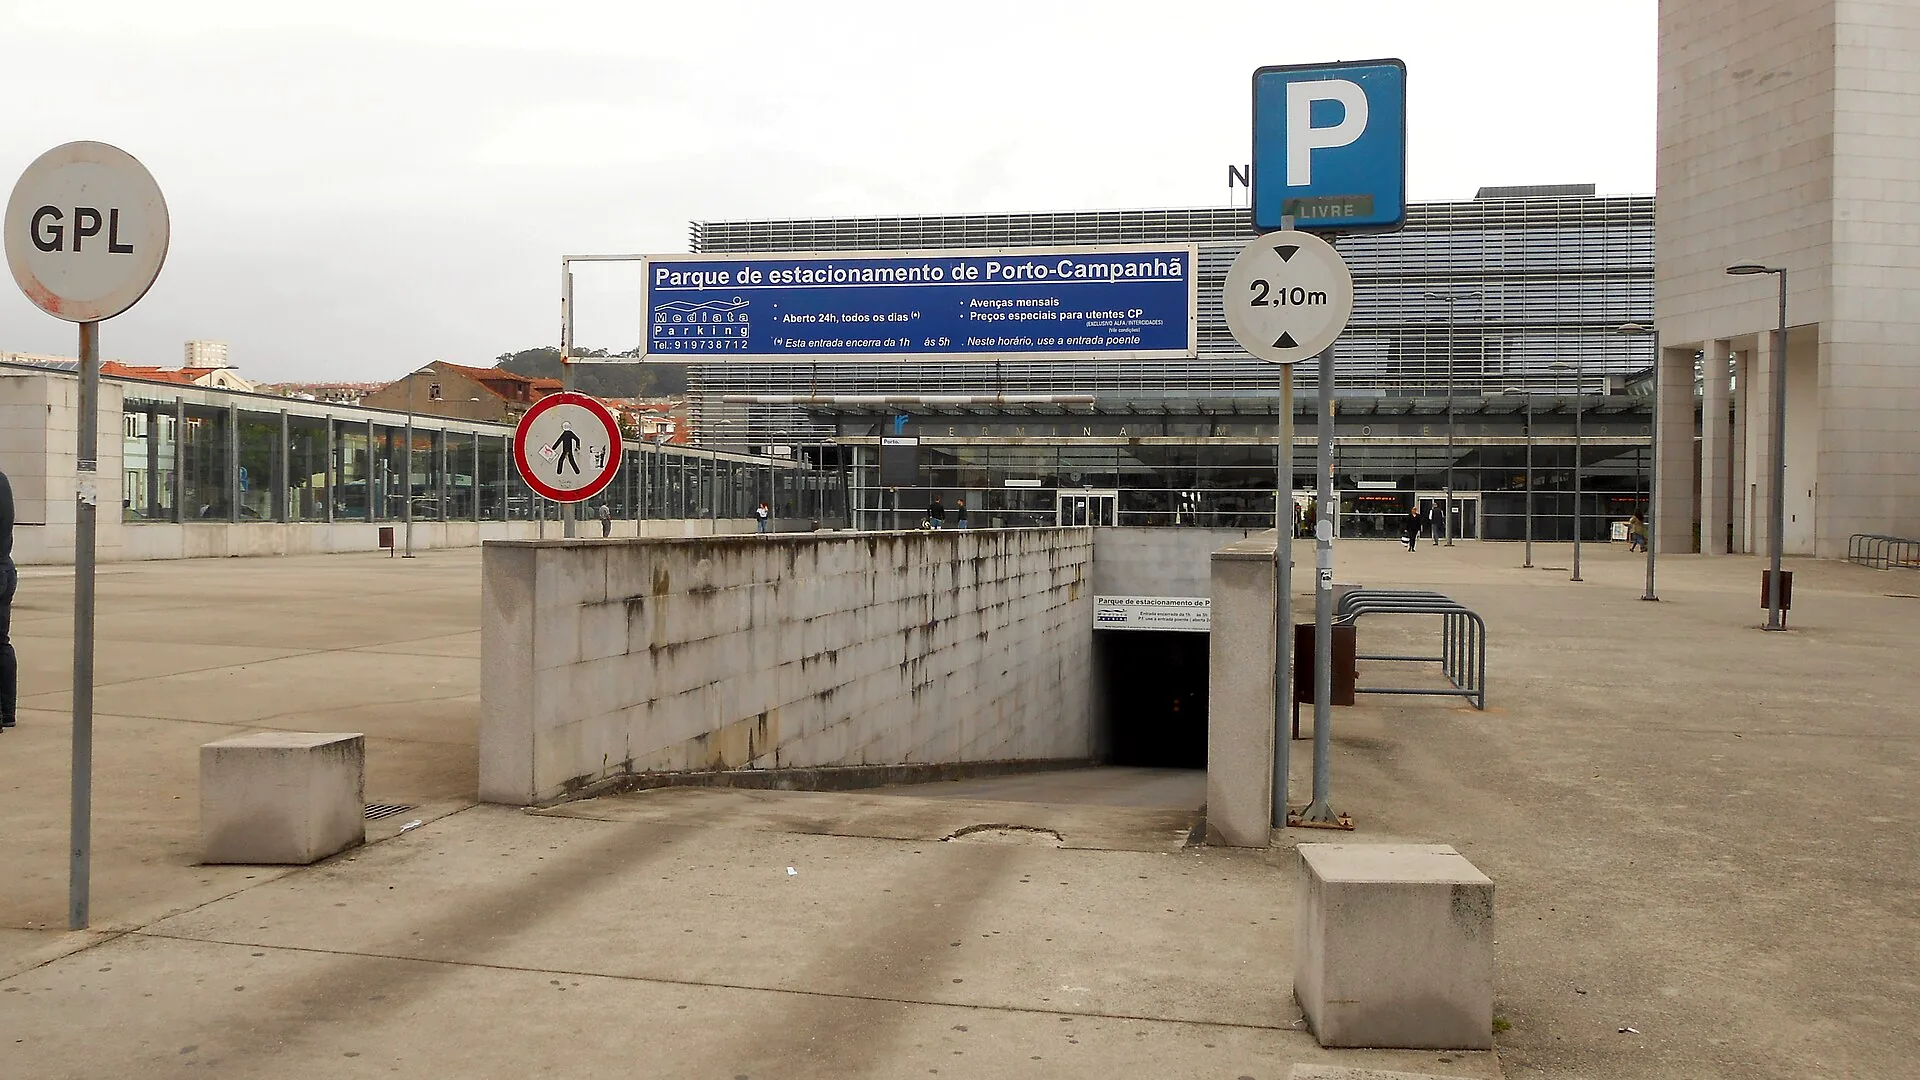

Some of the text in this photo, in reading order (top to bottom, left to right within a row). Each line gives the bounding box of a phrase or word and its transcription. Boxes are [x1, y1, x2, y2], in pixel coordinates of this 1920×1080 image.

[1286, 79, 1369, 187] P
[1300, 204, 1355, 219] LIVRE
[30, 205, 134, 254] GPL
[656, 258, 1182, 291] Parque de estacionamento de Porto-Campanhã
[1250, 279, 1327, 308] 2,10m
[969, 297, 1060, 310] Avenças mensais
[655, 312, 749, 323] Mediata
[782, 314, 816, 323] Aberto
[818, 313, 839, 324] 24h,
[841, 313, 870, 322] todos
[873, 314, 885, 322] os
[888, 312, 909, 322] dias
[970, 309, 1143, 323] Preços especiais para utentes CP
[655, 325, 748, 337] Parking
[653, 340, 748, 350] Tel.: 919738712
[785, 338, 806, 348] Esta
[808, 338, 844, 348] entrada
[846, 338, 881, 348] encerra
[883, 337, 896, 347] da
[899, 337, 911, 347] 1h
[938, 336, 950, 347] 5h
[967, 336, 995, 346] Neste
[997, 336, 1034, 347] horário,
[1037, 337, 1055, 346] use
[1057, 337, 1064, 346] a
[1066, 335, 1104, 346] entrada
[1105, 335, 1141, 347] poente
[1098, 597, 1124, 606] Parque
